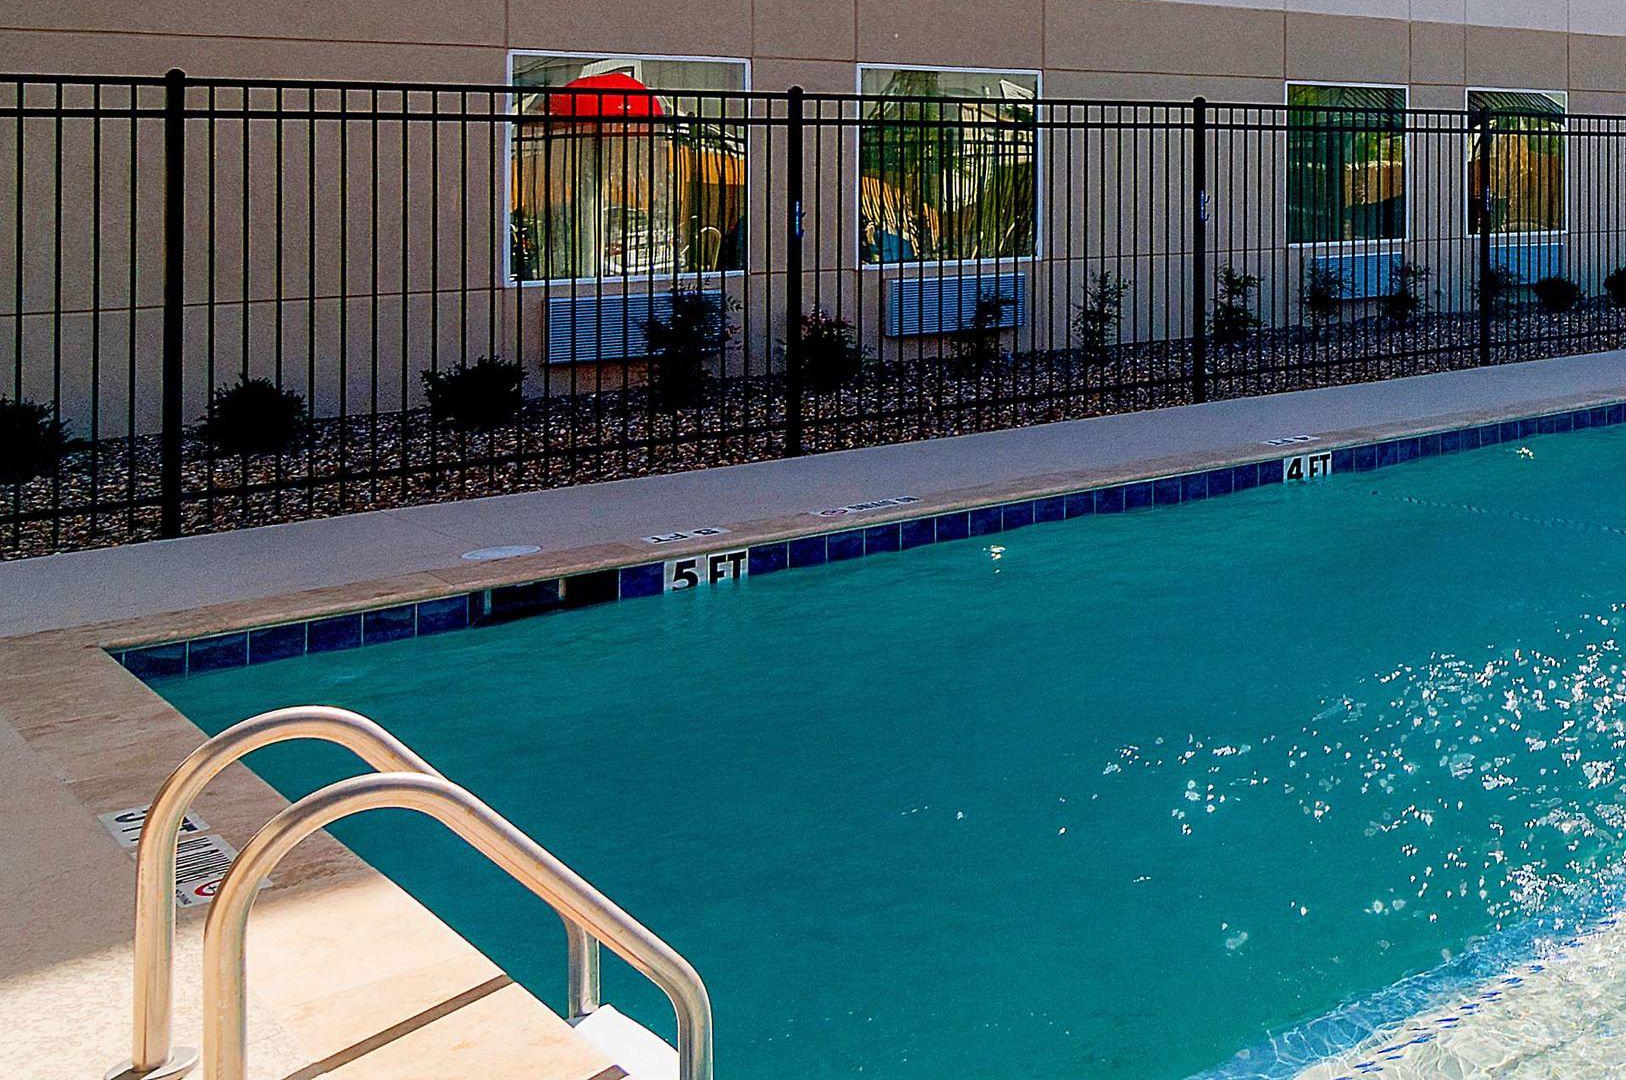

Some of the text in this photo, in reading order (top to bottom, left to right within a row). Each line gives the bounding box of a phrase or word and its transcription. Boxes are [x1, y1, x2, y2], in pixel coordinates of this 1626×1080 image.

[1286, 453, 1331, 480] 4 FT
[672, 550, 748, 590] 5 FT
